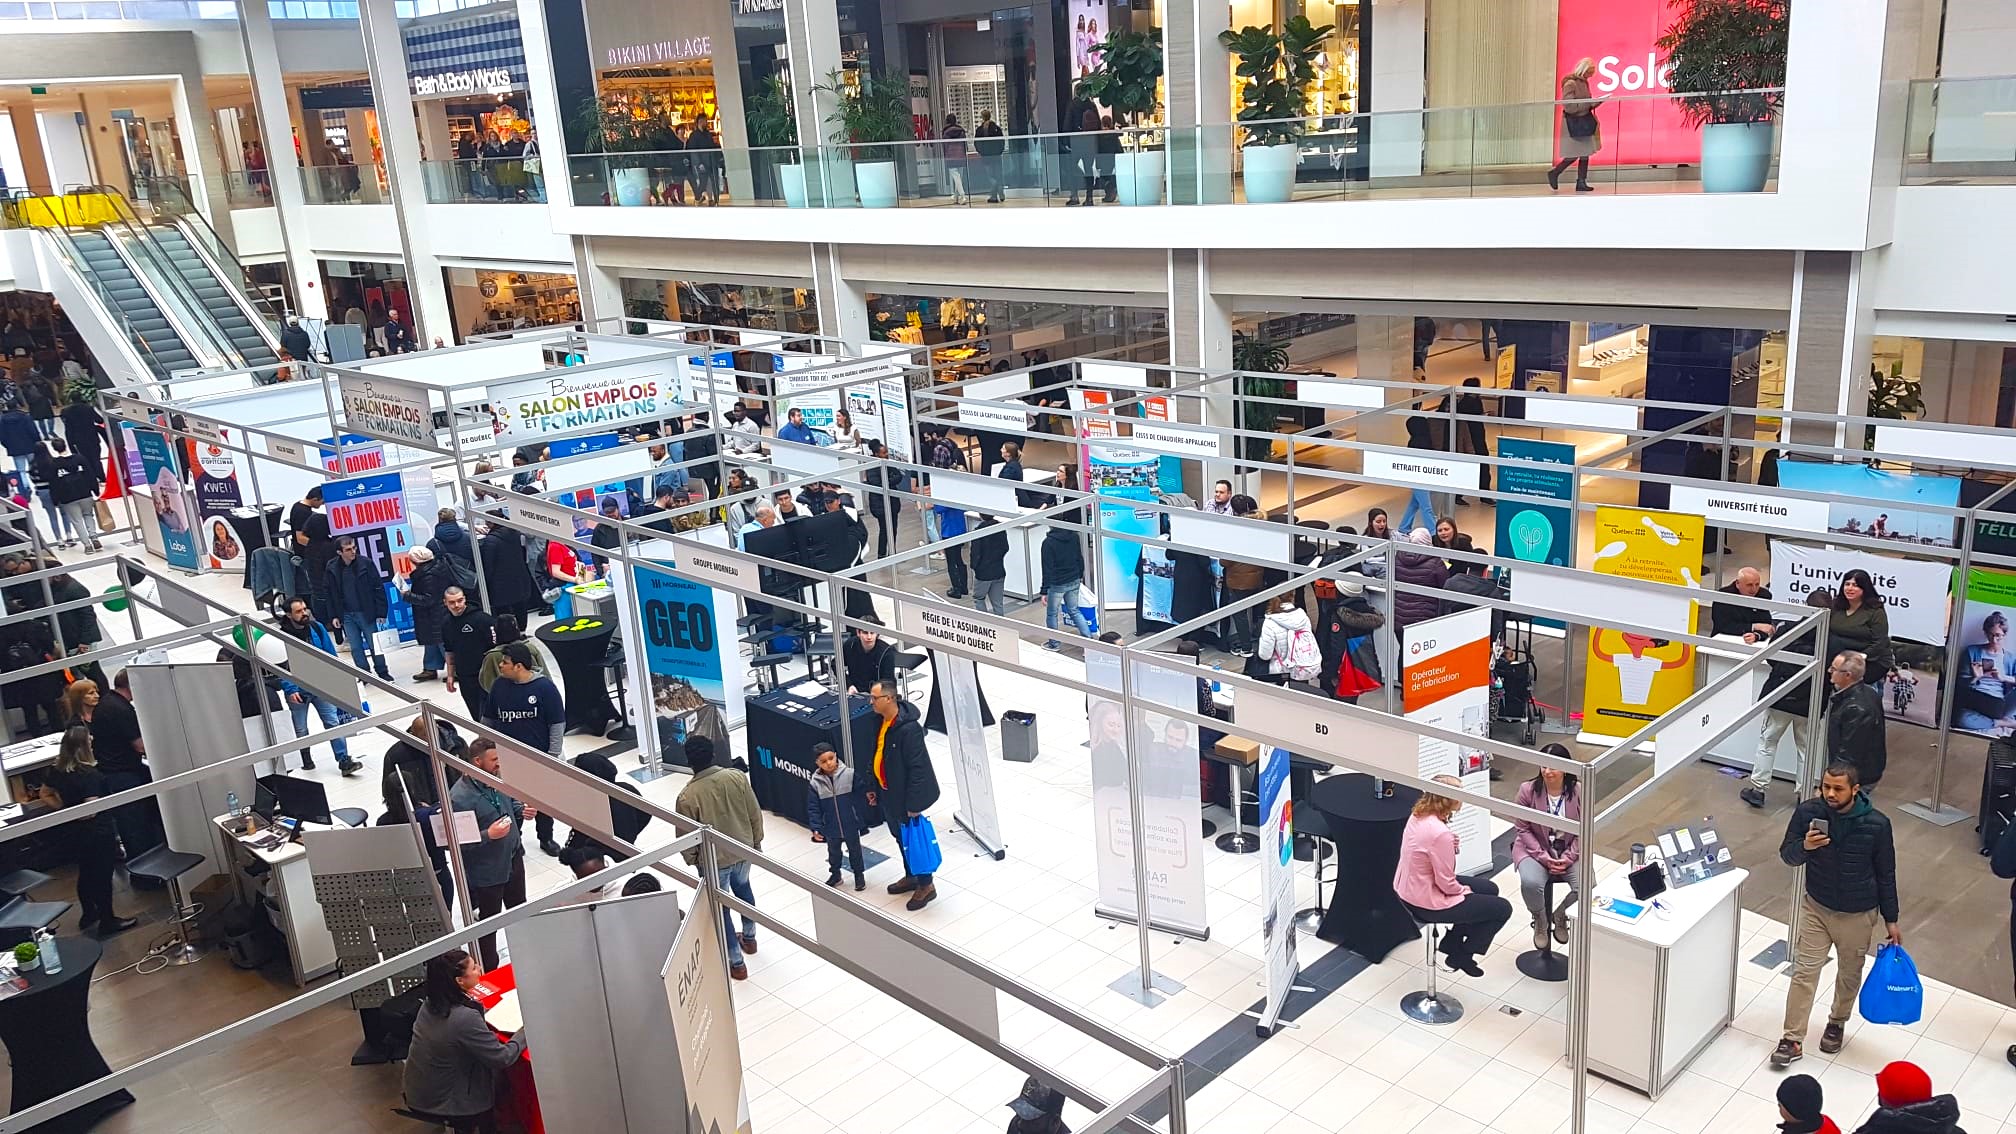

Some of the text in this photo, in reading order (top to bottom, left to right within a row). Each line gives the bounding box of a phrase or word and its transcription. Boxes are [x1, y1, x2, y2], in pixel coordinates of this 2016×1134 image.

[608, 36, 712, 65] BIKINI VILLAGE
[415, 75, 440, 95] Bath
[439, 73, 448, 92] &
[447, 70, 476, 93] Body
[474, 66, 511, 88] Works
[546, 378, 626, 397] Bienvenue au
[520, 382, 658, 419] SALON EMPLOIS
[354, 398, 420, 424] SALON EMPLOIS
[525, 398, 656, 432] ET FORMATIONS
[358, 413, 422, 440] ET FORMATIONS
[469, 432, 492, 444] QUÉBEC
[1392, 462, 1449, 476] RETRAITE QUÉBEC
[332, 497, 402, 530] ON DONNE
[1708, 498, 1787, 516] UNIVERSITÉ TÉLUQ
[396, 528, 405, 548] À
[1979, 520, 2016, 537] TÉLU
[693, 557, 738, 577] GROUPE MORNEAU
[1791, 562, 1897, 589] L'univité
[662, 582, 697, 591] MORNEAU
[1790, 580, 1810, 593] de
[645, 598, 713, 652] GEO
[922, 611, 996, 639] RÉGIE DE L'ASSURANCE
[926, 626, 994, 652] MALADIE DU QUÉBEC
[1423, 639, 1436, 651] BD
[1412, 665, 1447, 682] Opérateur
[1412, 672, 1460, 691] de fabrication
[1315, 723, 1328, 735] BD
[1702, 714, 1709, 727] BD
[774, 757, 812, 781] MORNE
[678, 938, 700, 1008] ÉNAP
